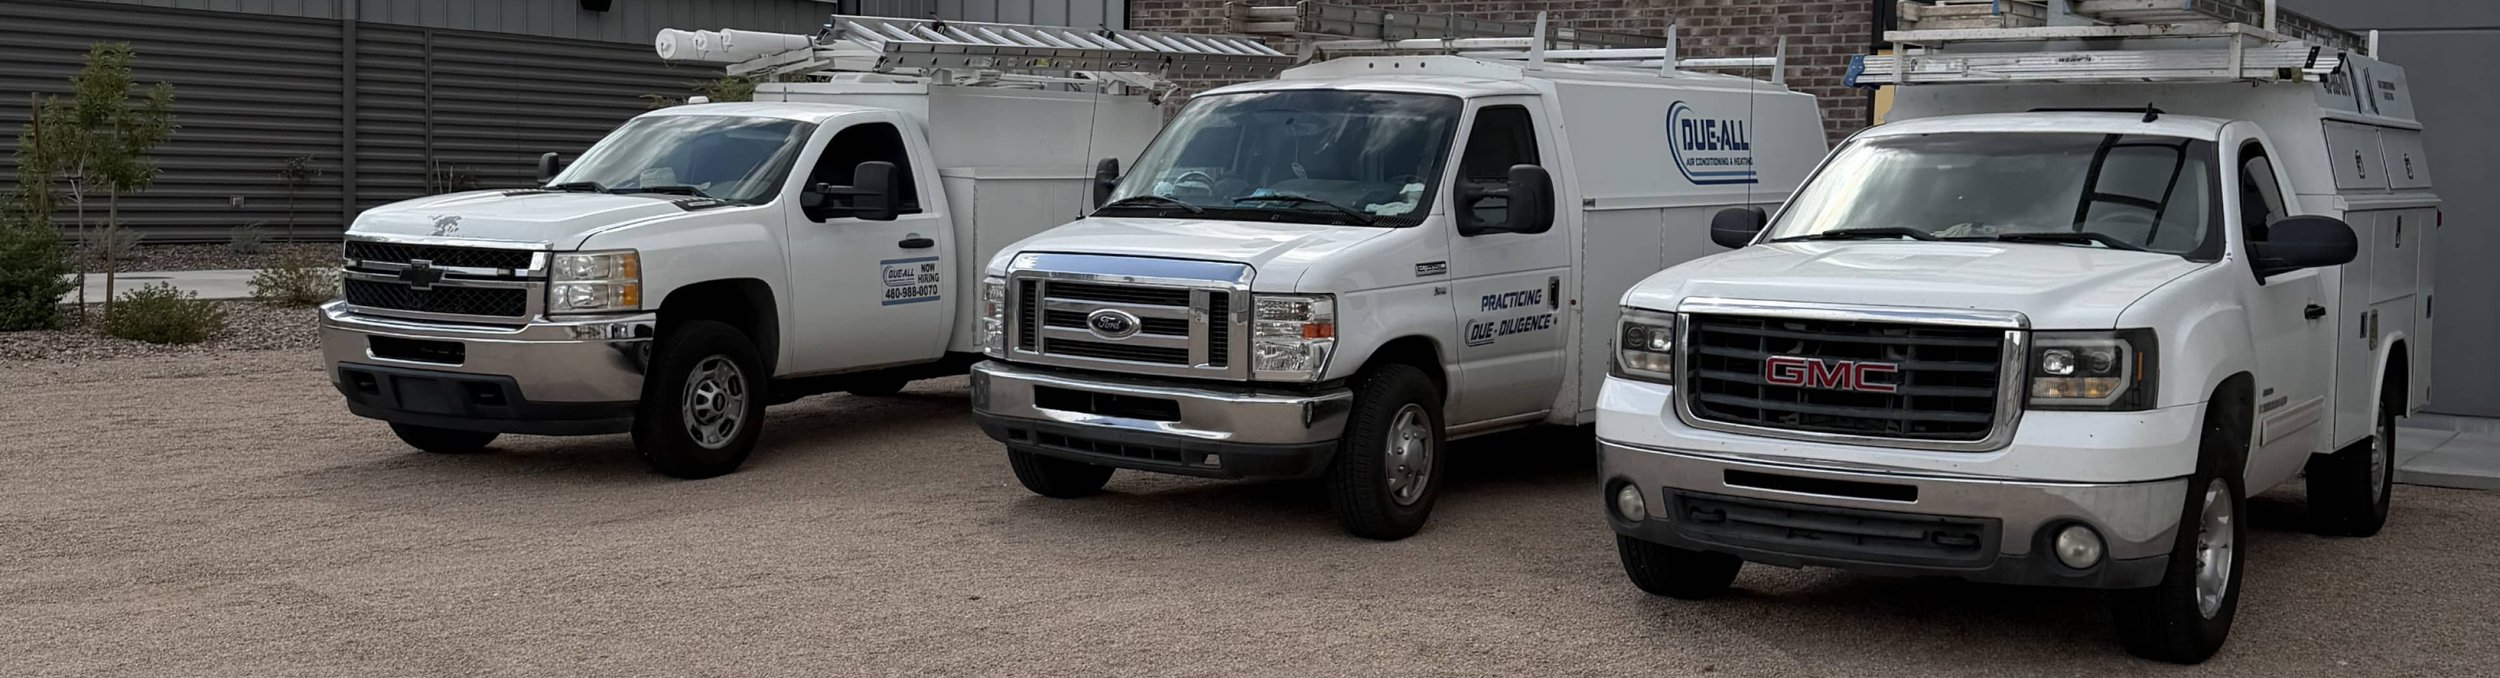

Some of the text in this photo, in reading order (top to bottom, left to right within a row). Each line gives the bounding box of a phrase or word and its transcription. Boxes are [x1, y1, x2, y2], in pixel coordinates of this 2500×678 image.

[921, 263, 935, 273] NOW
[917, 273, 940, 284] HIRING
[885, 284, 938, 298] 480-988-0070
[1481, 288, 1542, 312] PRACTICING
[1098, 315, 1121, 330] Ford
[1765, 355, 1898, 393] GMC
